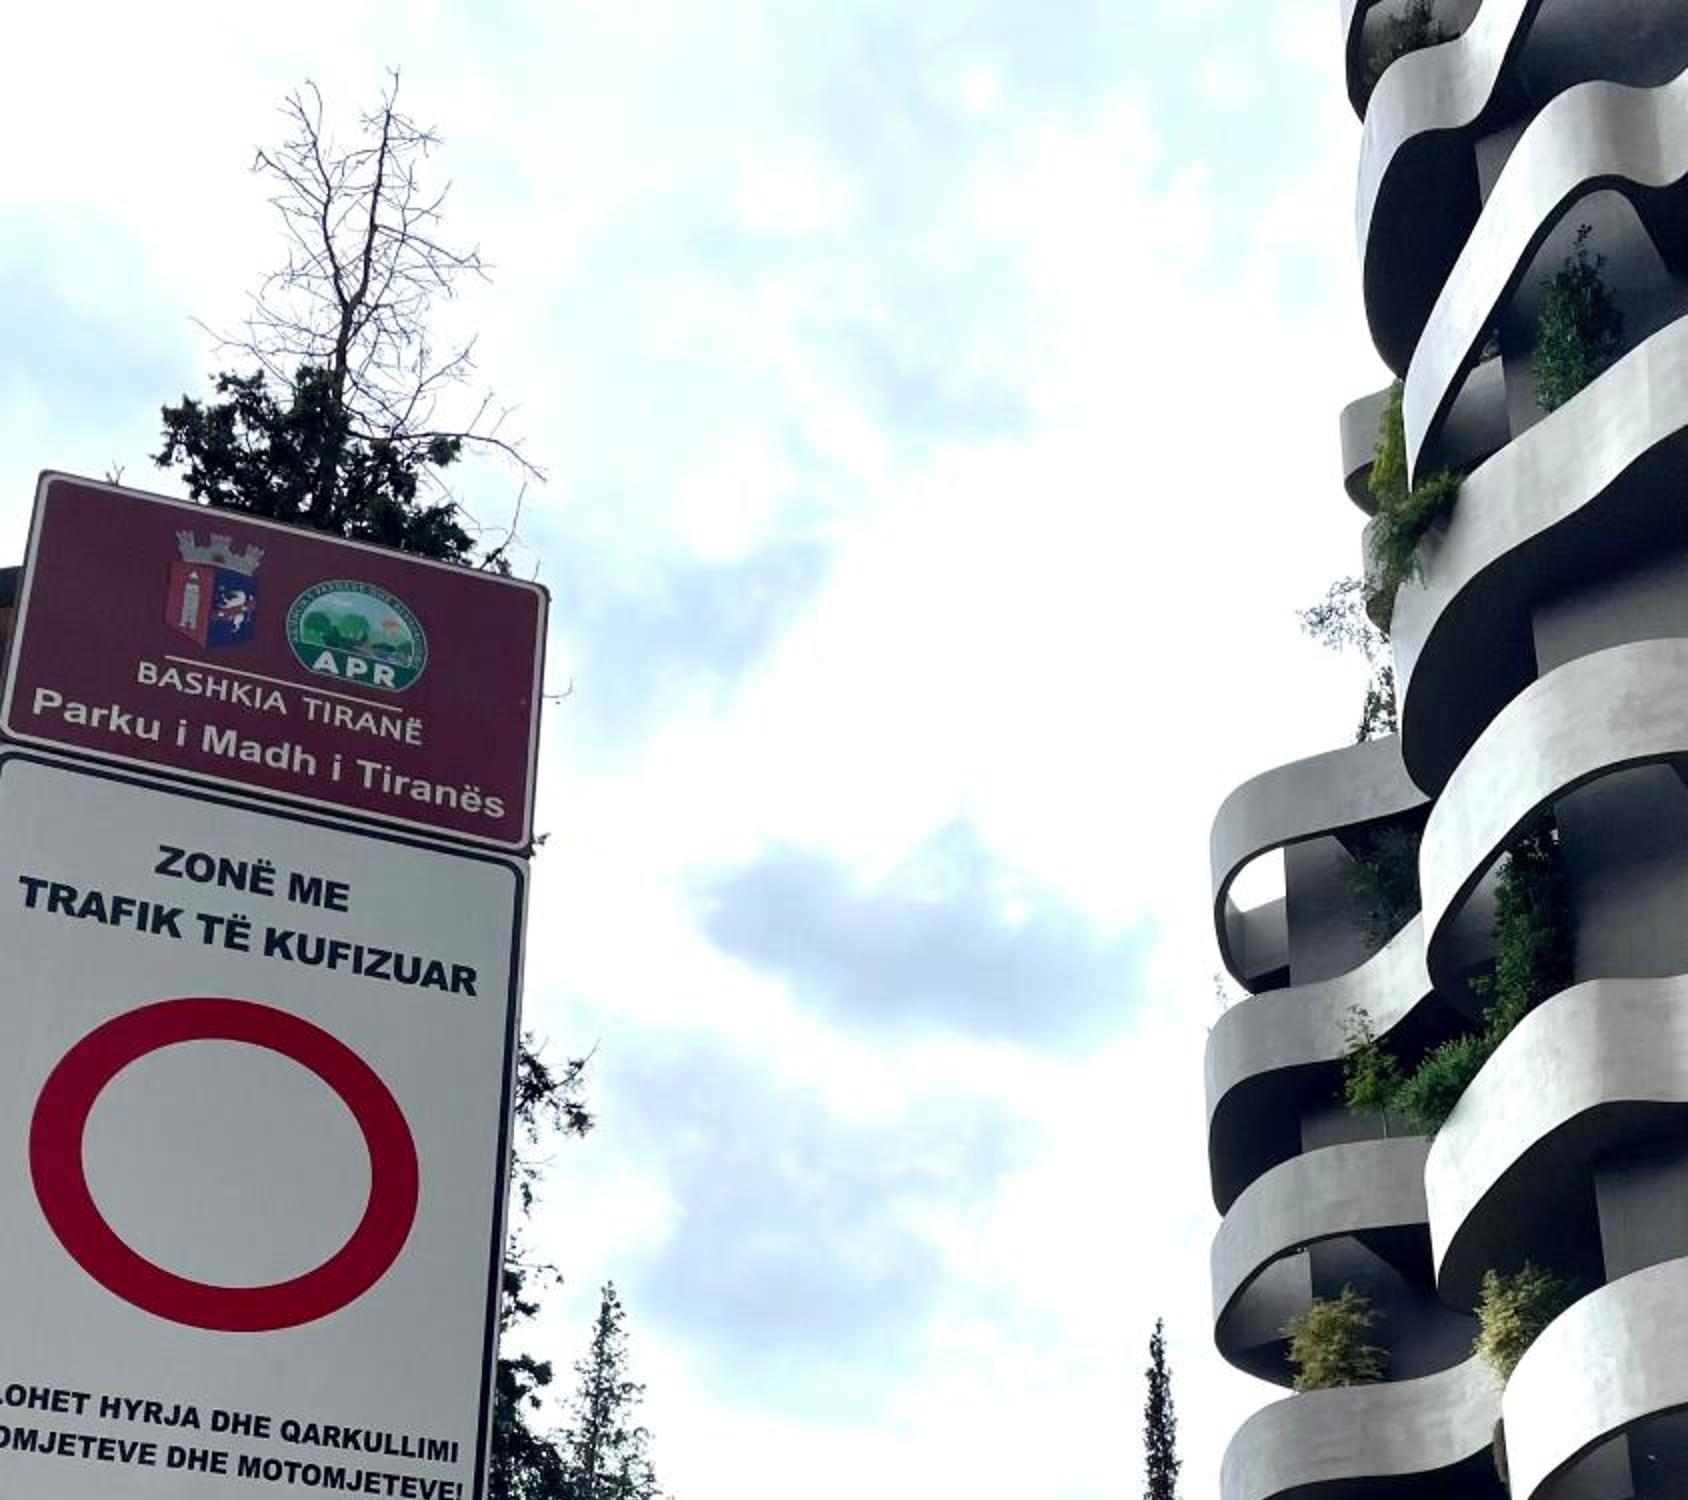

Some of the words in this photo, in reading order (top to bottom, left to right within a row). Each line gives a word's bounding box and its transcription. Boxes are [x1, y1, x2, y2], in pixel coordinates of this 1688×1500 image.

[138, 661, 287, 715] BASHKIA
[303, 697, 422, 745] TIRANË
[313, 651, 396, 689] APR
[33, 687, 160, 741] Parku
[177, 719, 187, 746] i
[203, 725, 316, 775] Madh
[332, 754, 341, 781] i
[357, 759, 505, 819] Tiranës
[155, 845, 276, 897] ZONË
[288, 873, 350, 912] ME
[19, 875, 184, 939] TRAFIK
[197, 912, 251, 952] TË
[263, 928, 477, 996] KUFIZUAR
[0, 1384, 90, 1415] OHET
[100, 1396, 200, 1429] HYRJA
[211, 1410, 271, 1438] DHE
[281, 1420, 458, 1463] QARKULLIMI
[167, 1446, 228, 1475] DHE
